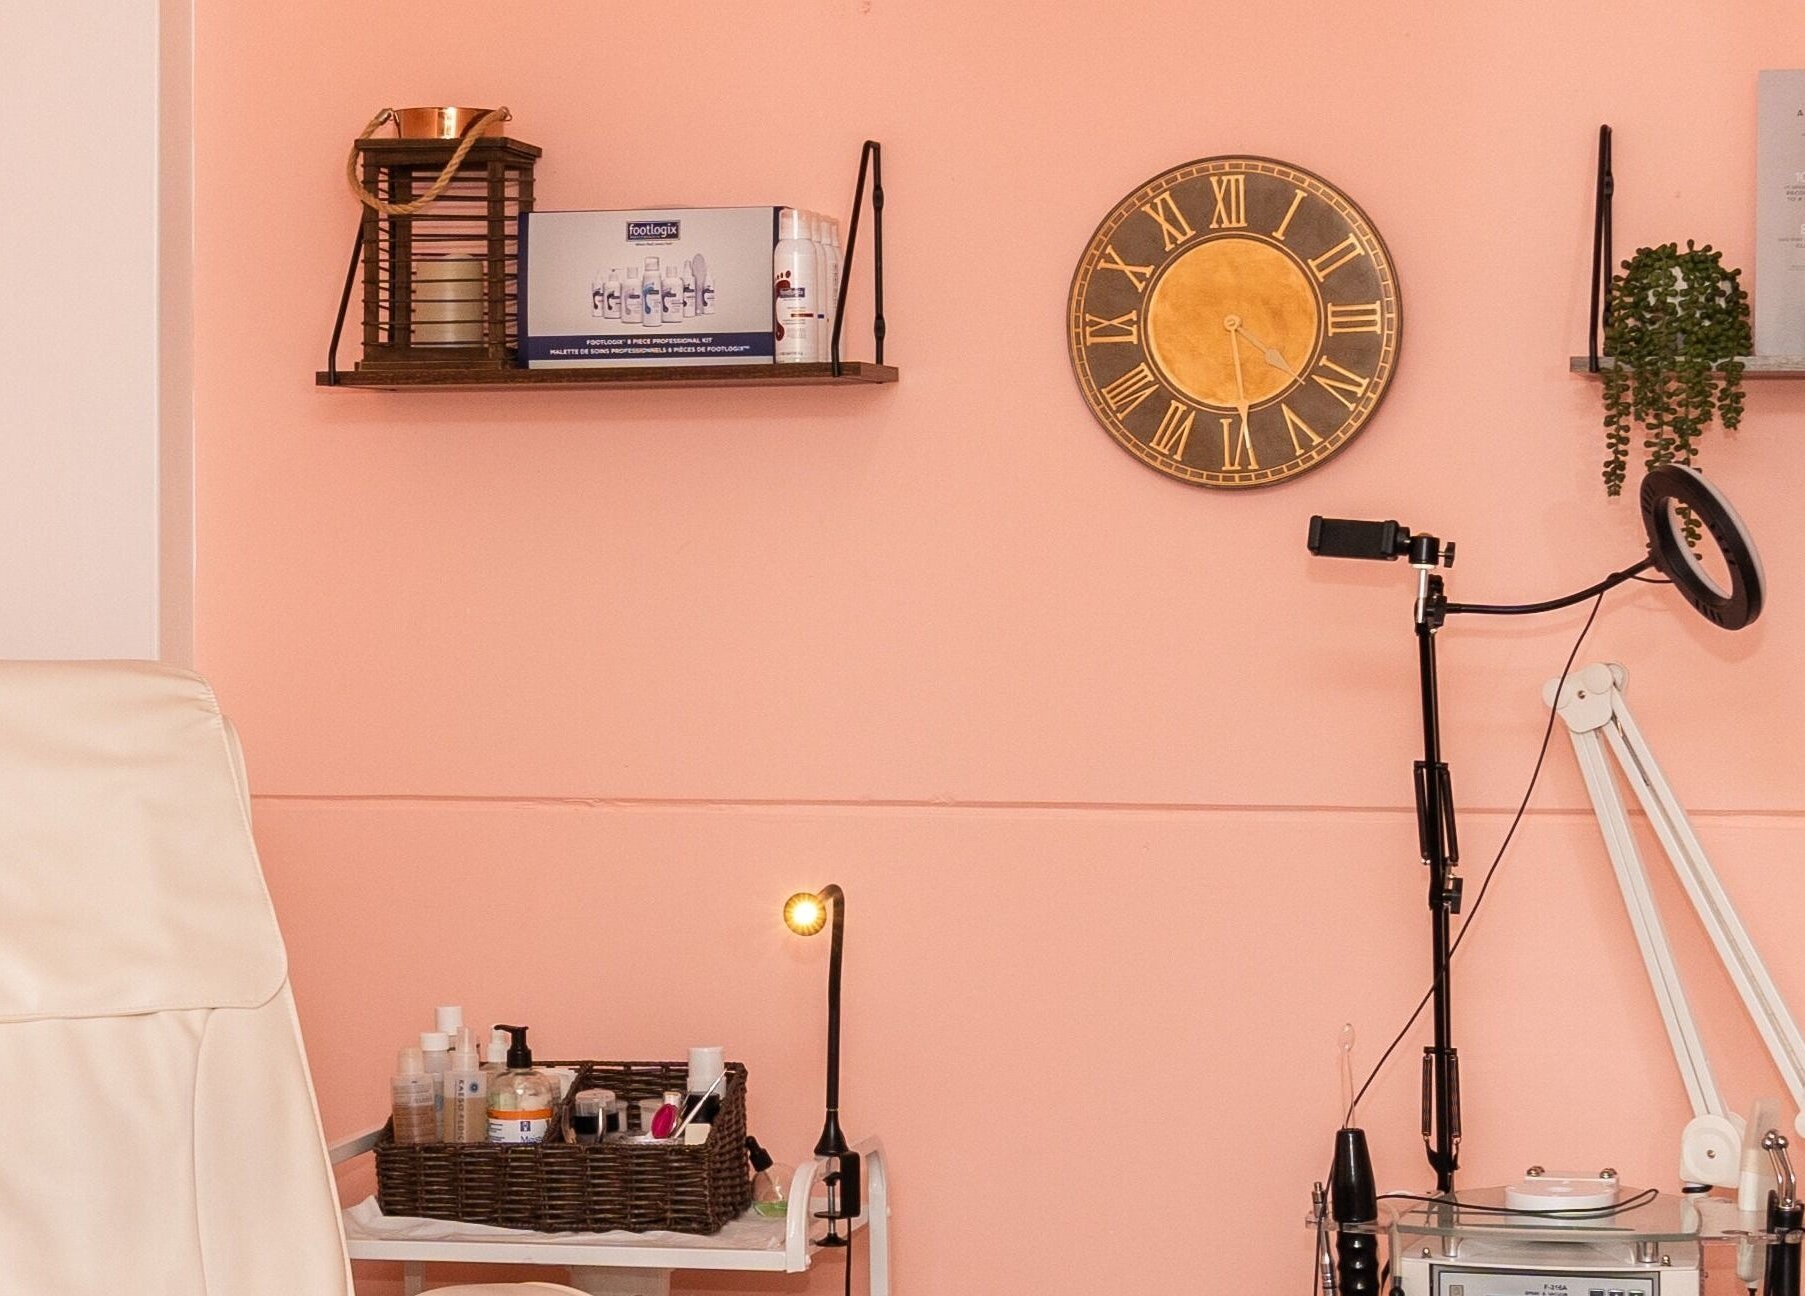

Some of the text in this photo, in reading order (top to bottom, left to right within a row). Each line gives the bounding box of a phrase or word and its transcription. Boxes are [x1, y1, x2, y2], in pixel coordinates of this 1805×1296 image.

[1141, 190, 1196, 252] XI
[1209, 174, 1248, 229] XII
[1272, 189, 1307, 241] I
[629, 223, 677, 238] footlogix
[1097, 245, 1155, 293] X
[1307, 233, 1366, 282] II
[1085, 309, 1139, 346] IX
[1327, 300, 1382, 337] III
[1101, 362, 1160, 421] VIII
[1311, 355, 1370, 412] IV
[1149, 399, 1196, 461] VII
[1219, 416, 1259, 470] VI
[1280, 403, 1324, 456] V
